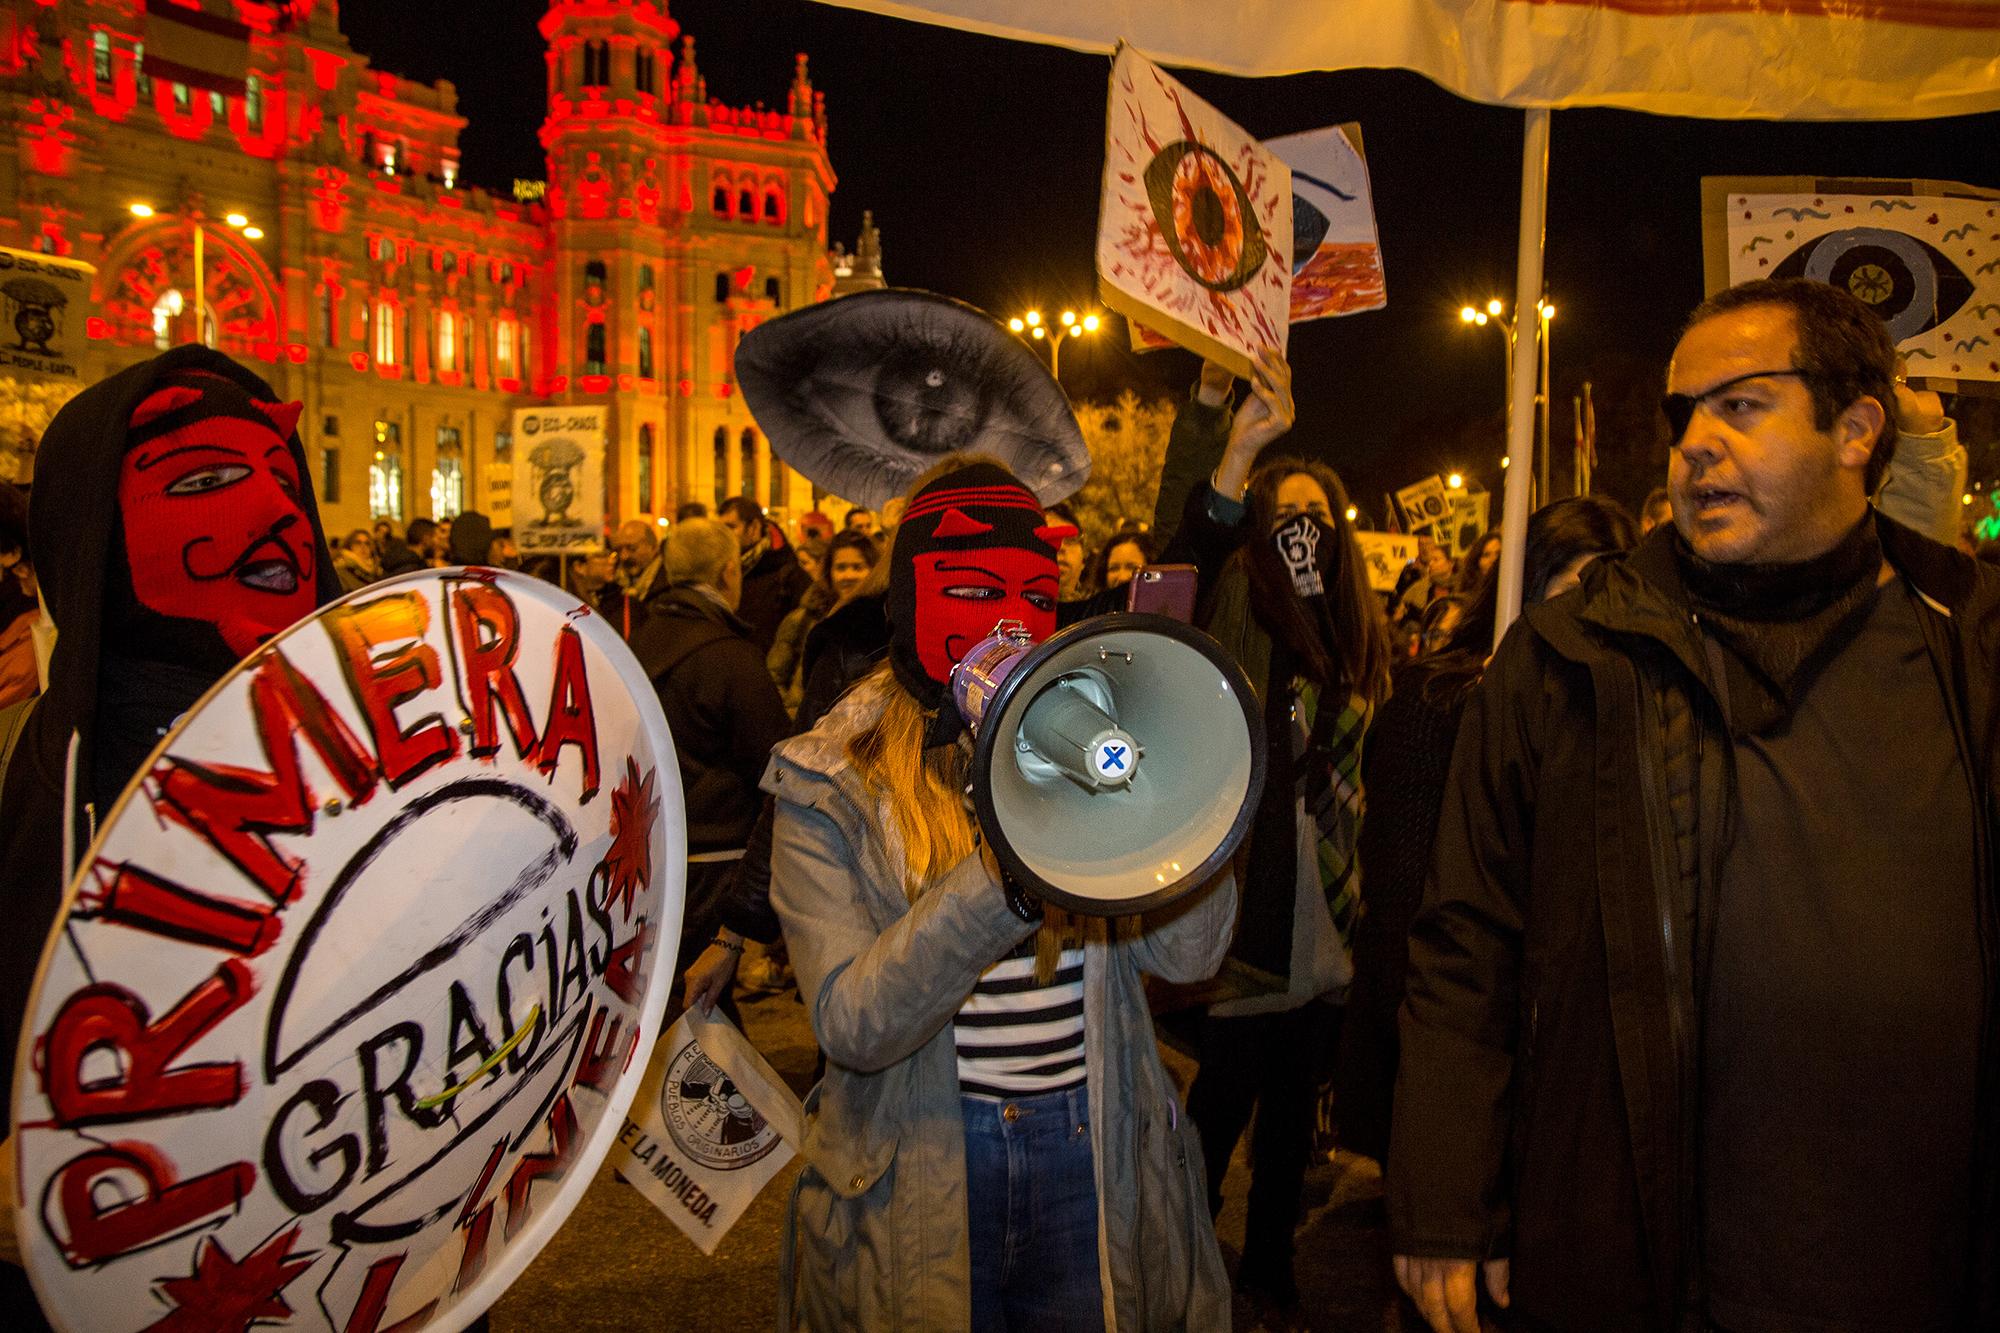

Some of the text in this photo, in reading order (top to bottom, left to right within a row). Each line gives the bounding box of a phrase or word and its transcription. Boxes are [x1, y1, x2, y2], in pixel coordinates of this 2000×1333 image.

[38, 574, 602, 1272] PRIMERA
[630, 1134, 658, 1165] LA
[668, 1081, 760, 1158] PUEBLOS ORIGINARIOS
